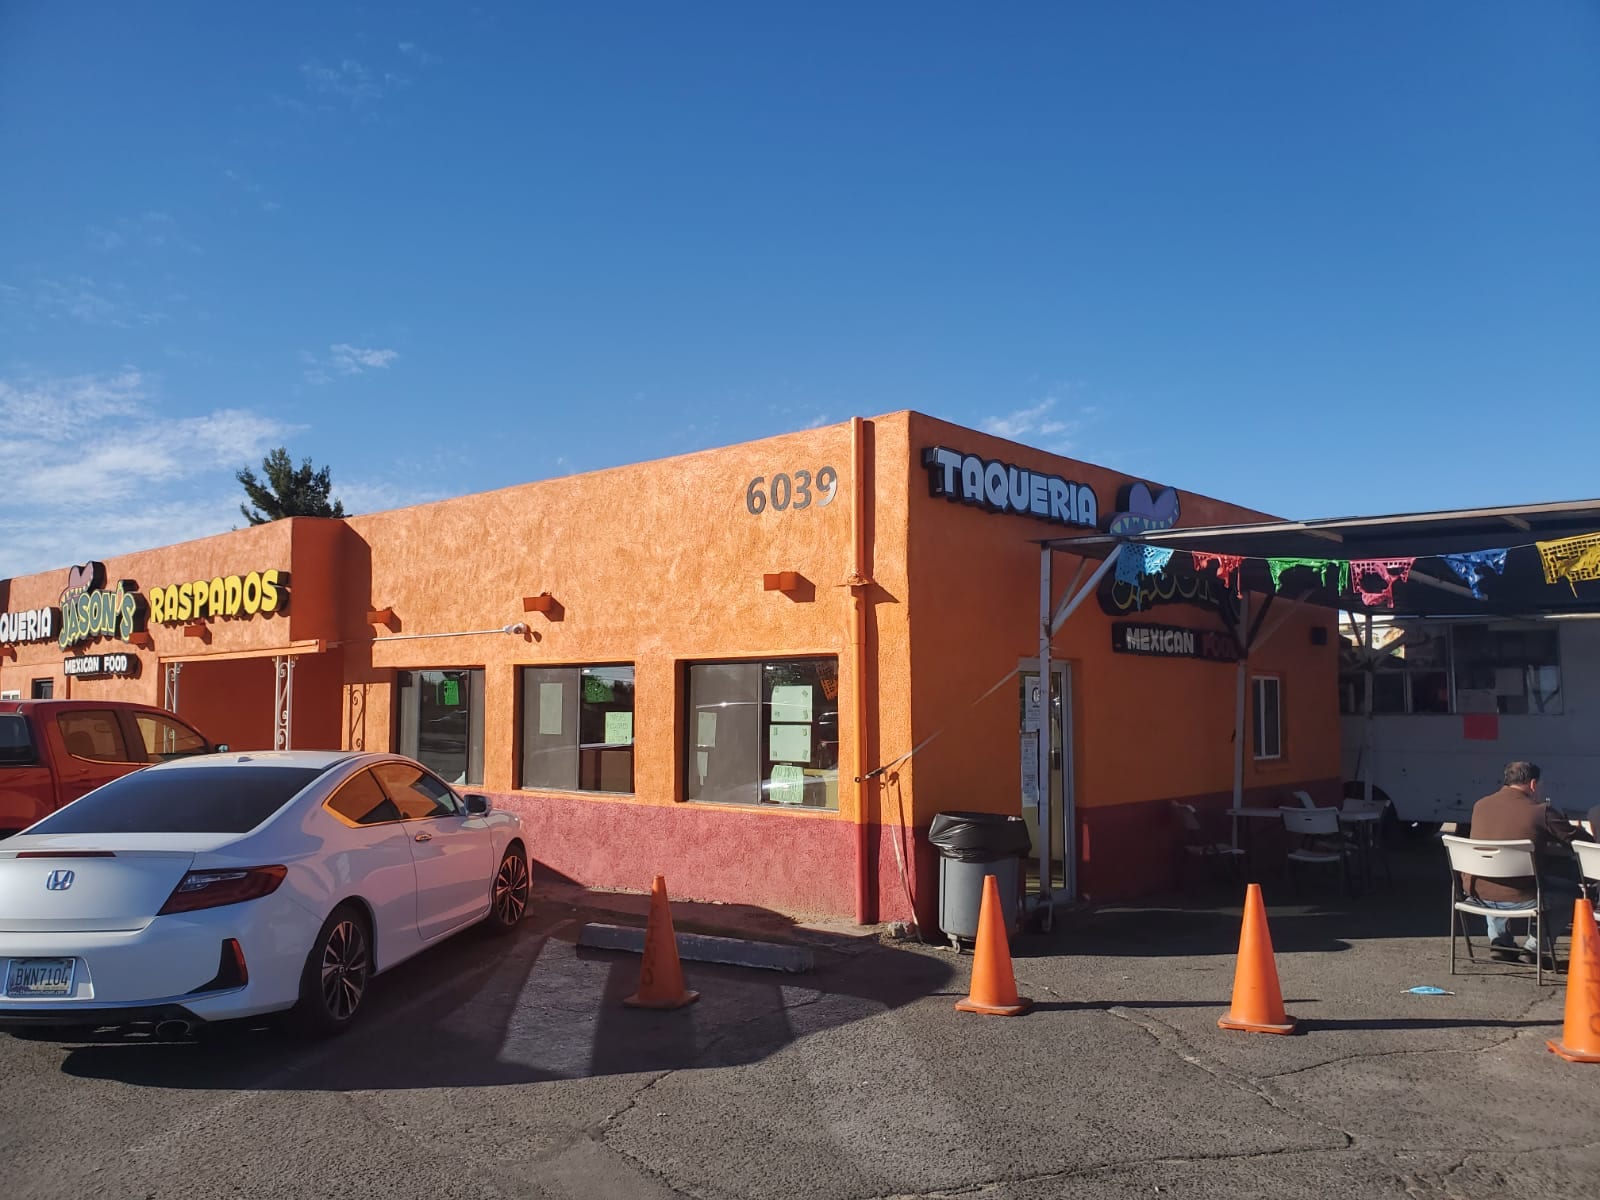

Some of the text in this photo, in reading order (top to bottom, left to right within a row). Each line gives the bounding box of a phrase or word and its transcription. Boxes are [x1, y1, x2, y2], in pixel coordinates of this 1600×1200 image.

[746, 465, 838, 516] 6039
[936, 448, 1098, 528] TAQUERIA
[149, 569, 278, 624] RASPADOS
[64, 655, 128, 675] MEXICAN FOOD
[1126, 627, 1194, 654] MEXICAN
